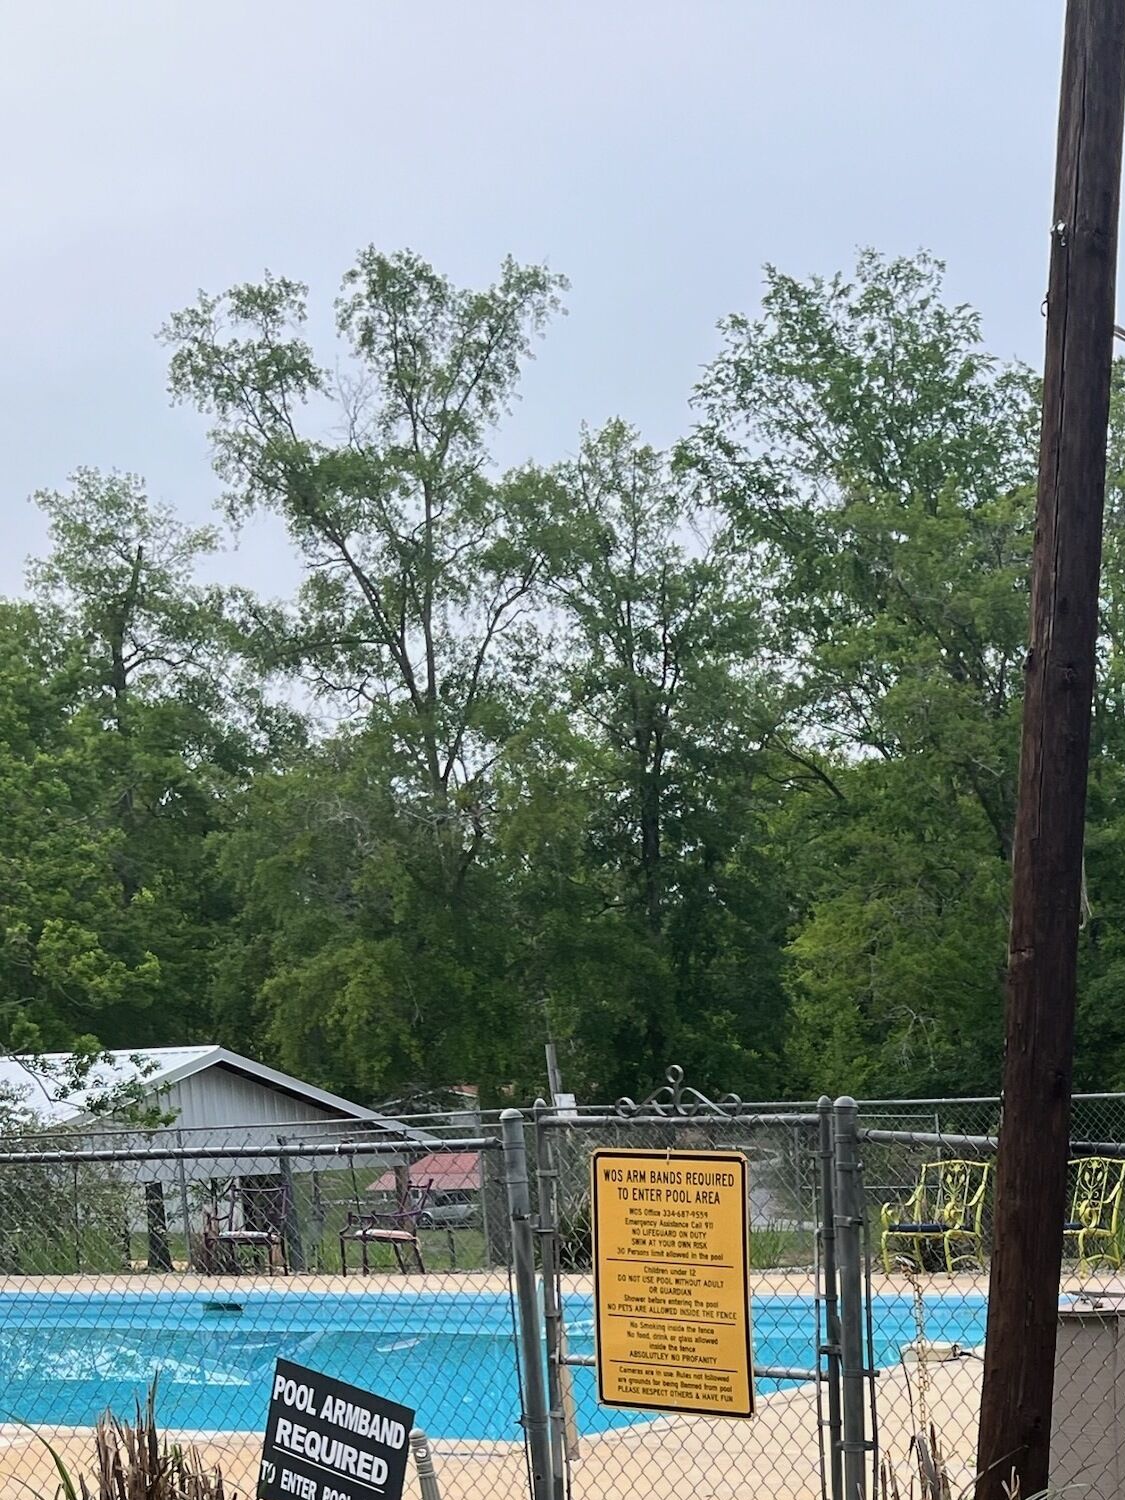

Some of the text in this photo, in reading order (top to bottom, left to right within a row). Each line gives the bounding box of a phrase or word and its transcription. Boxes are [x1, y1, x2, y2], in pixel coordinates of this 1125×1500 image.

[603, 1169, 735, 1187] WOS ARM BANDS REQUIRED
[617, 1187, 720, 1204] TO ENTER POOL AREA
[643, 1208, 661, 1217] Office
[625, 1218, 657, 1228] Emergency
[660, 1219, 689, 1228] Assistance
[691, 1221, 702, 1229] Call
[642, 1229, 677, 1238] LIFEGUARD
[690, 1231, 707, 1239] DUTY
[632, 1238, 646, 1246] SWIM
[693, 1242, 708, 1250] RISK
[627, 1248, 649, 1256] Persons
[651, 1249, 664, 1257] limit
[666, 1251, 689, 1259] allowed
[644, 1265, 668, 1274] Children
[642, 1276, 654, 1284] USE
[656, 1277, 673, 1285] POOL
[675, 1279, 701, 1287] WITHOUT
[704, 1280, 724, 1288] ADULT
[660, 1287, 692, 1296] GUARDIAN
[624, 1294, 646, 1302] Shower
[648, 1296, 666, 1304] before
[668, 1299, 692, 1308] entering
[618, 1304, 633, 1312] PETS
[635, 1305, 646, 1313] ARE
[649, 1306, 677, 1315] ALLOWED
[680, 1308, 700, 1317] INSIDE
[702, 1310, 715, 1318] THE
[716, 1311, 737, 1320] FENCE
[640, 1322, 665, 1332] Smoking
[667, 1324, 684, 1332] inside
[653, 1333, 668, 1341] drink
[649, 1342, 666, 1350] inside
[629, 1350, 668, 1360] ABSOLUTLEY
[682, 1355, 717, 1364] PROFANITY
[619, 1366, 643, 1375] Cameras
[676, 1371, 691, 1379] Rules
[704, 1374, 729, 1382] followed
[629, 1378, 651, 1387] grounds
[662, 1380, 679, 1389] being
[720, 1385, 732, 1393] pool
[618, 1385, 640, 1394] PLEASE
[642, 1387, 668, 1396] RESPECT
[670, 1390, 693, 1399] OTHERS
[702, 1394, 719, 1402] HAVE
[273, 1374, 406, 1450] POOL ARMBAND
[275, 1417, 388, 1486] REQUIRED
[261, 1459, 276, 1484] TO
